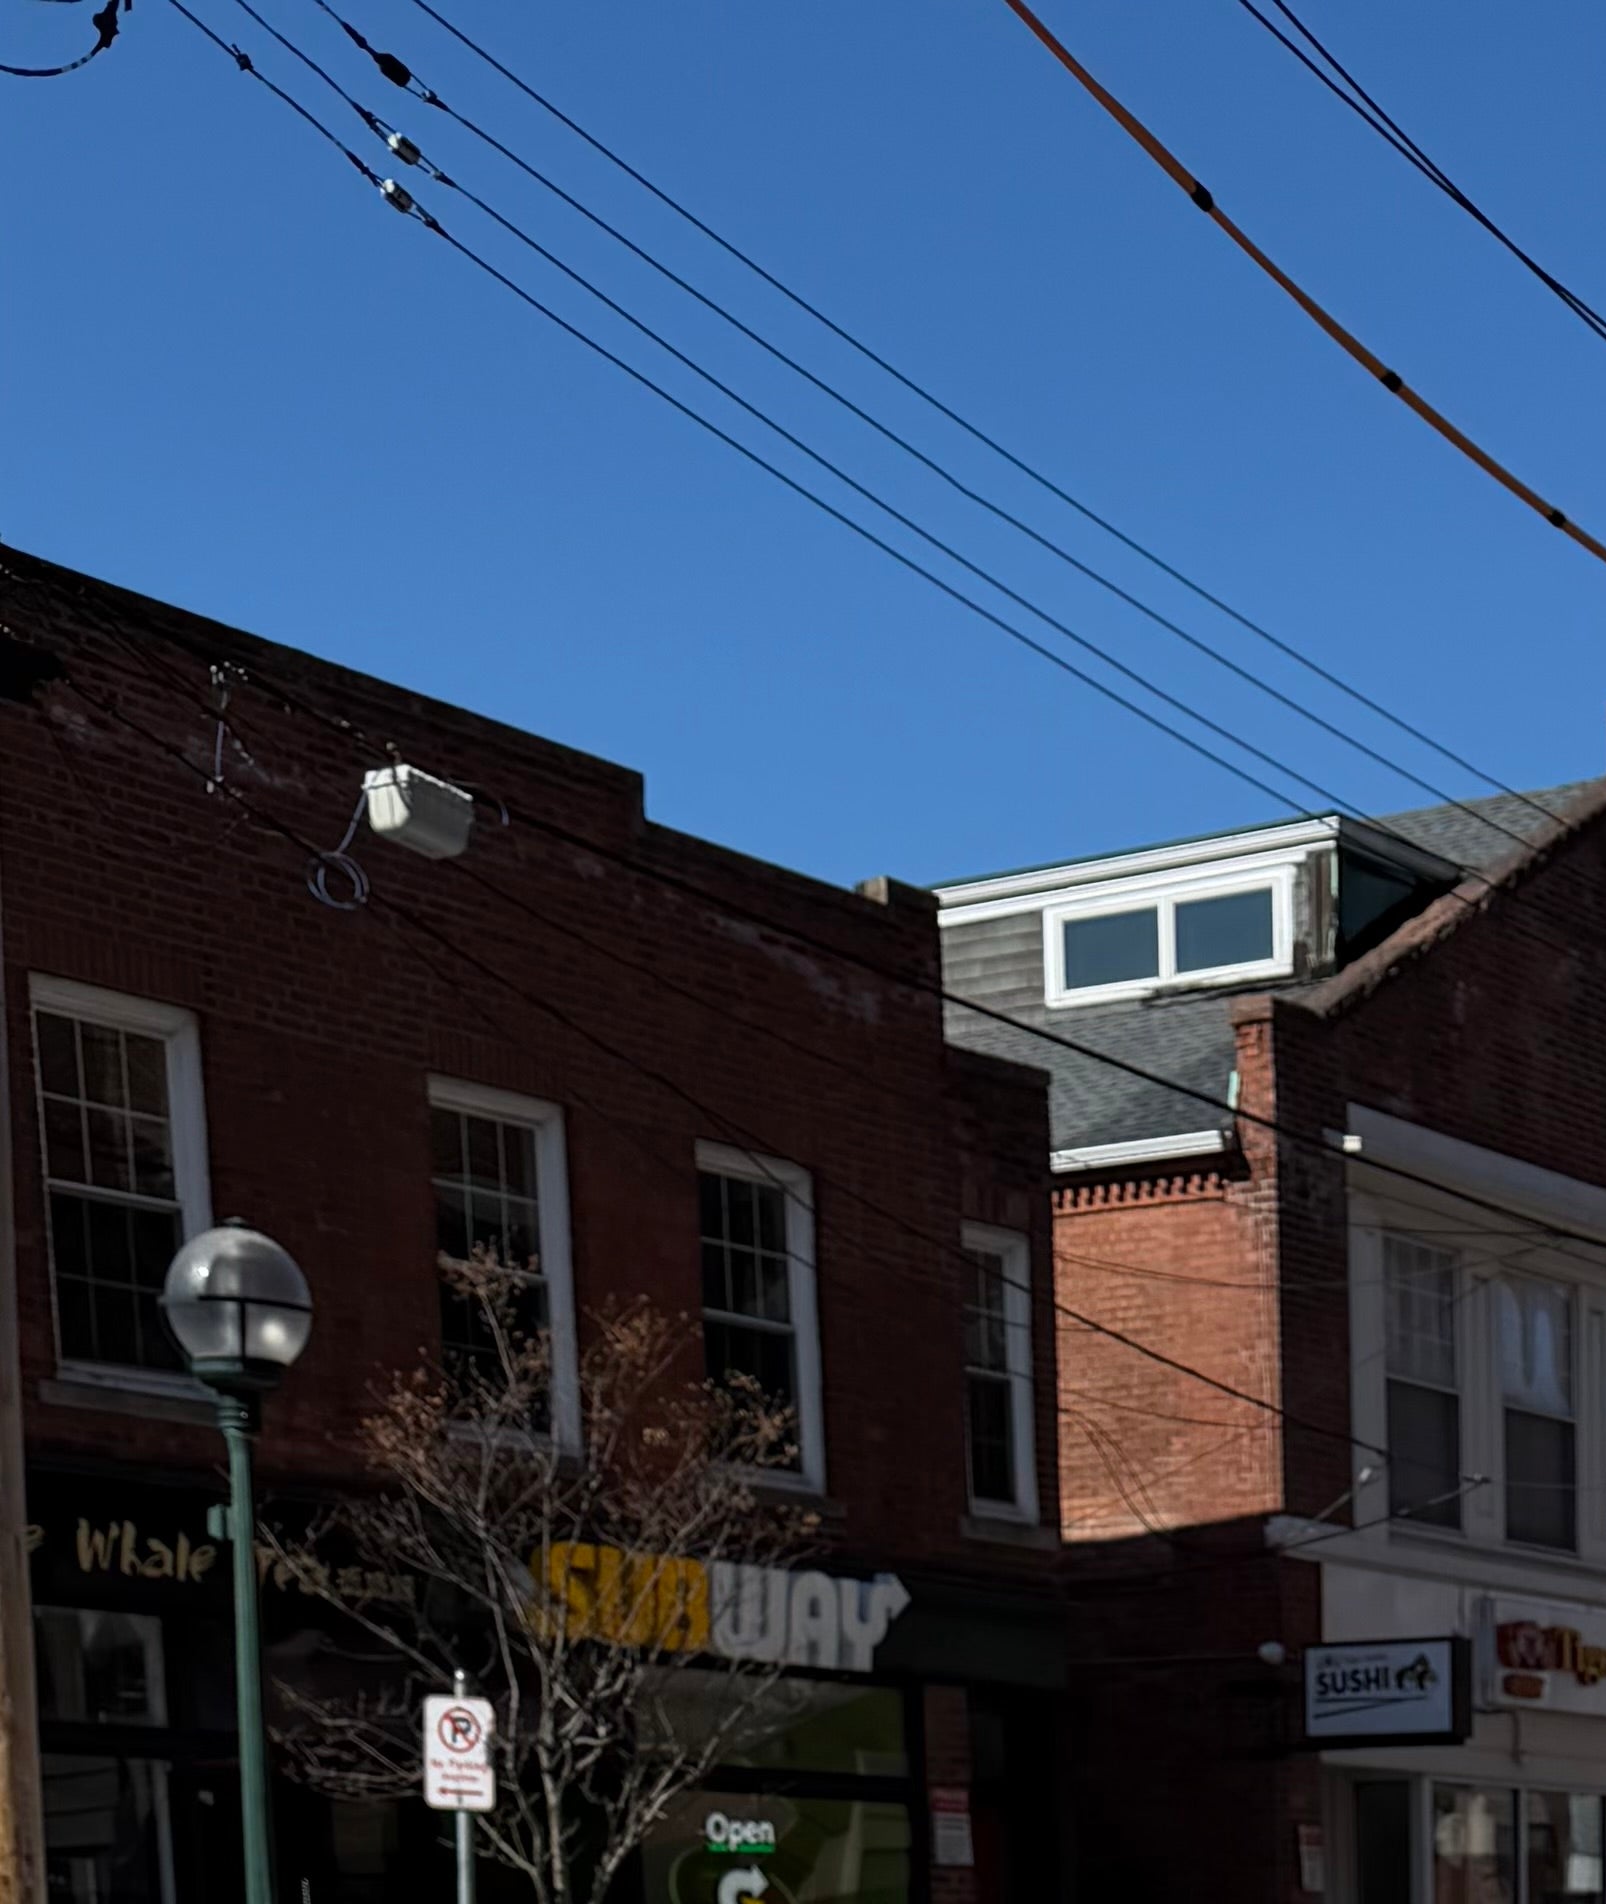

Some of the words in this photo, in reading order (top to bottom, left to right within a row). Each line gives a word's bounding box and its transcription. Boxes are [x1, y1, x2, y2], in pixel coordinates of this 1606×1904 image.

[76, 1517, 217, 1583] Whale
[529, 1541, 912, 1672] SUBWAY
[1317, 1667, 1390, 1696] SUSHI
[705, 1811, 776, 1851] Open
